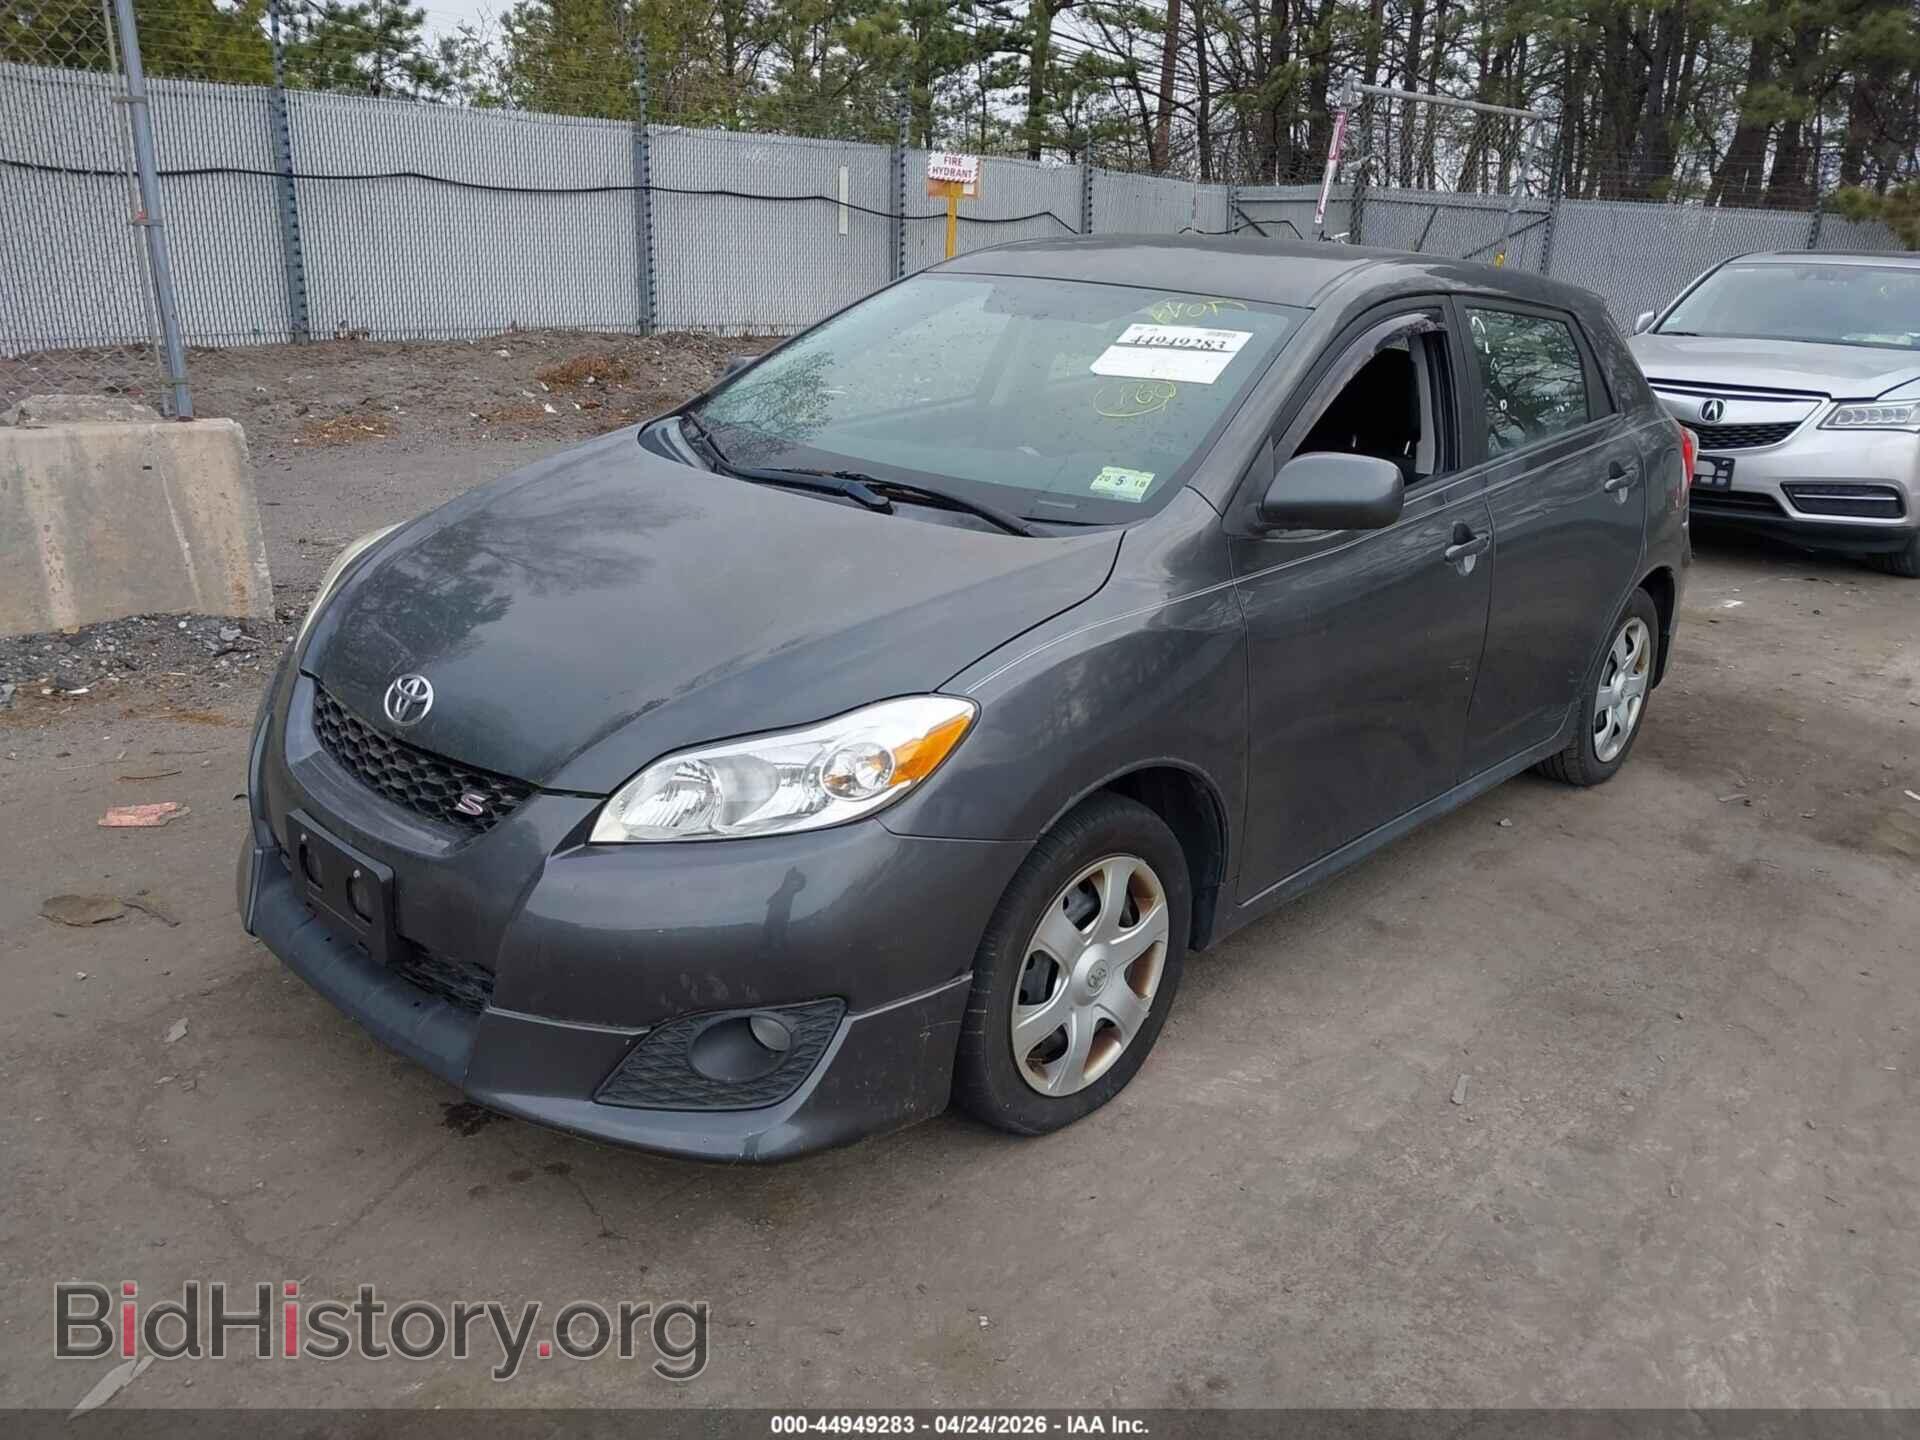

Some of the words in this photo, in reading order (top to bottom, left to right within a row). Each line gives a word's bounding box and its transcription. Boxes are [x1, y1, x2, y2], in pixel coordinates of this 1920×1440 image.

[944, 156, 963, 167] FIRE
[932, 167, 973, 178] HYDRANT
[1115, 475, 1127, 486] 5
